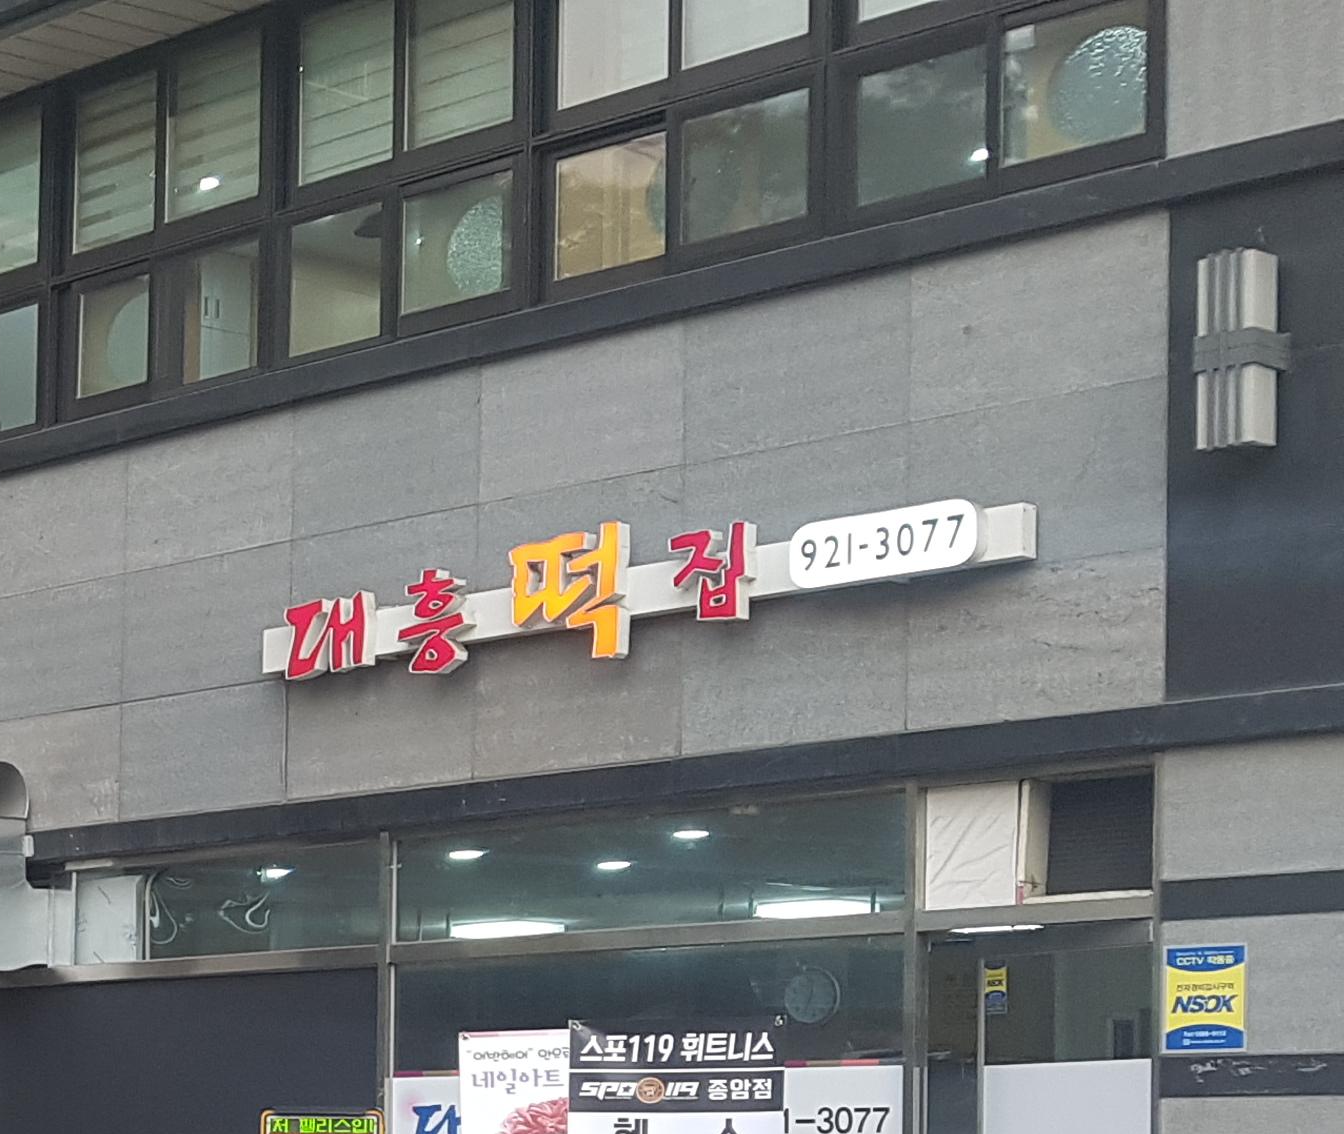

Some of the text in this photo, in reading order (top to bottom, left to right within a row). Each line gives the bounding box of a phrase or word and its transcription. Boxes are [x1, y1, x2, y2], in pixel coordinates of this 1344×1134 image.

[800, 513, 966, 571] 921-3077
[1172, 994, 1238, 1014] NSOK
[579, 1032, 775, 1063] 스포119 휘트니스
[472, 1068, 564, 1094] 네일아트
[708, 1078, 772, 1100] 종암점
